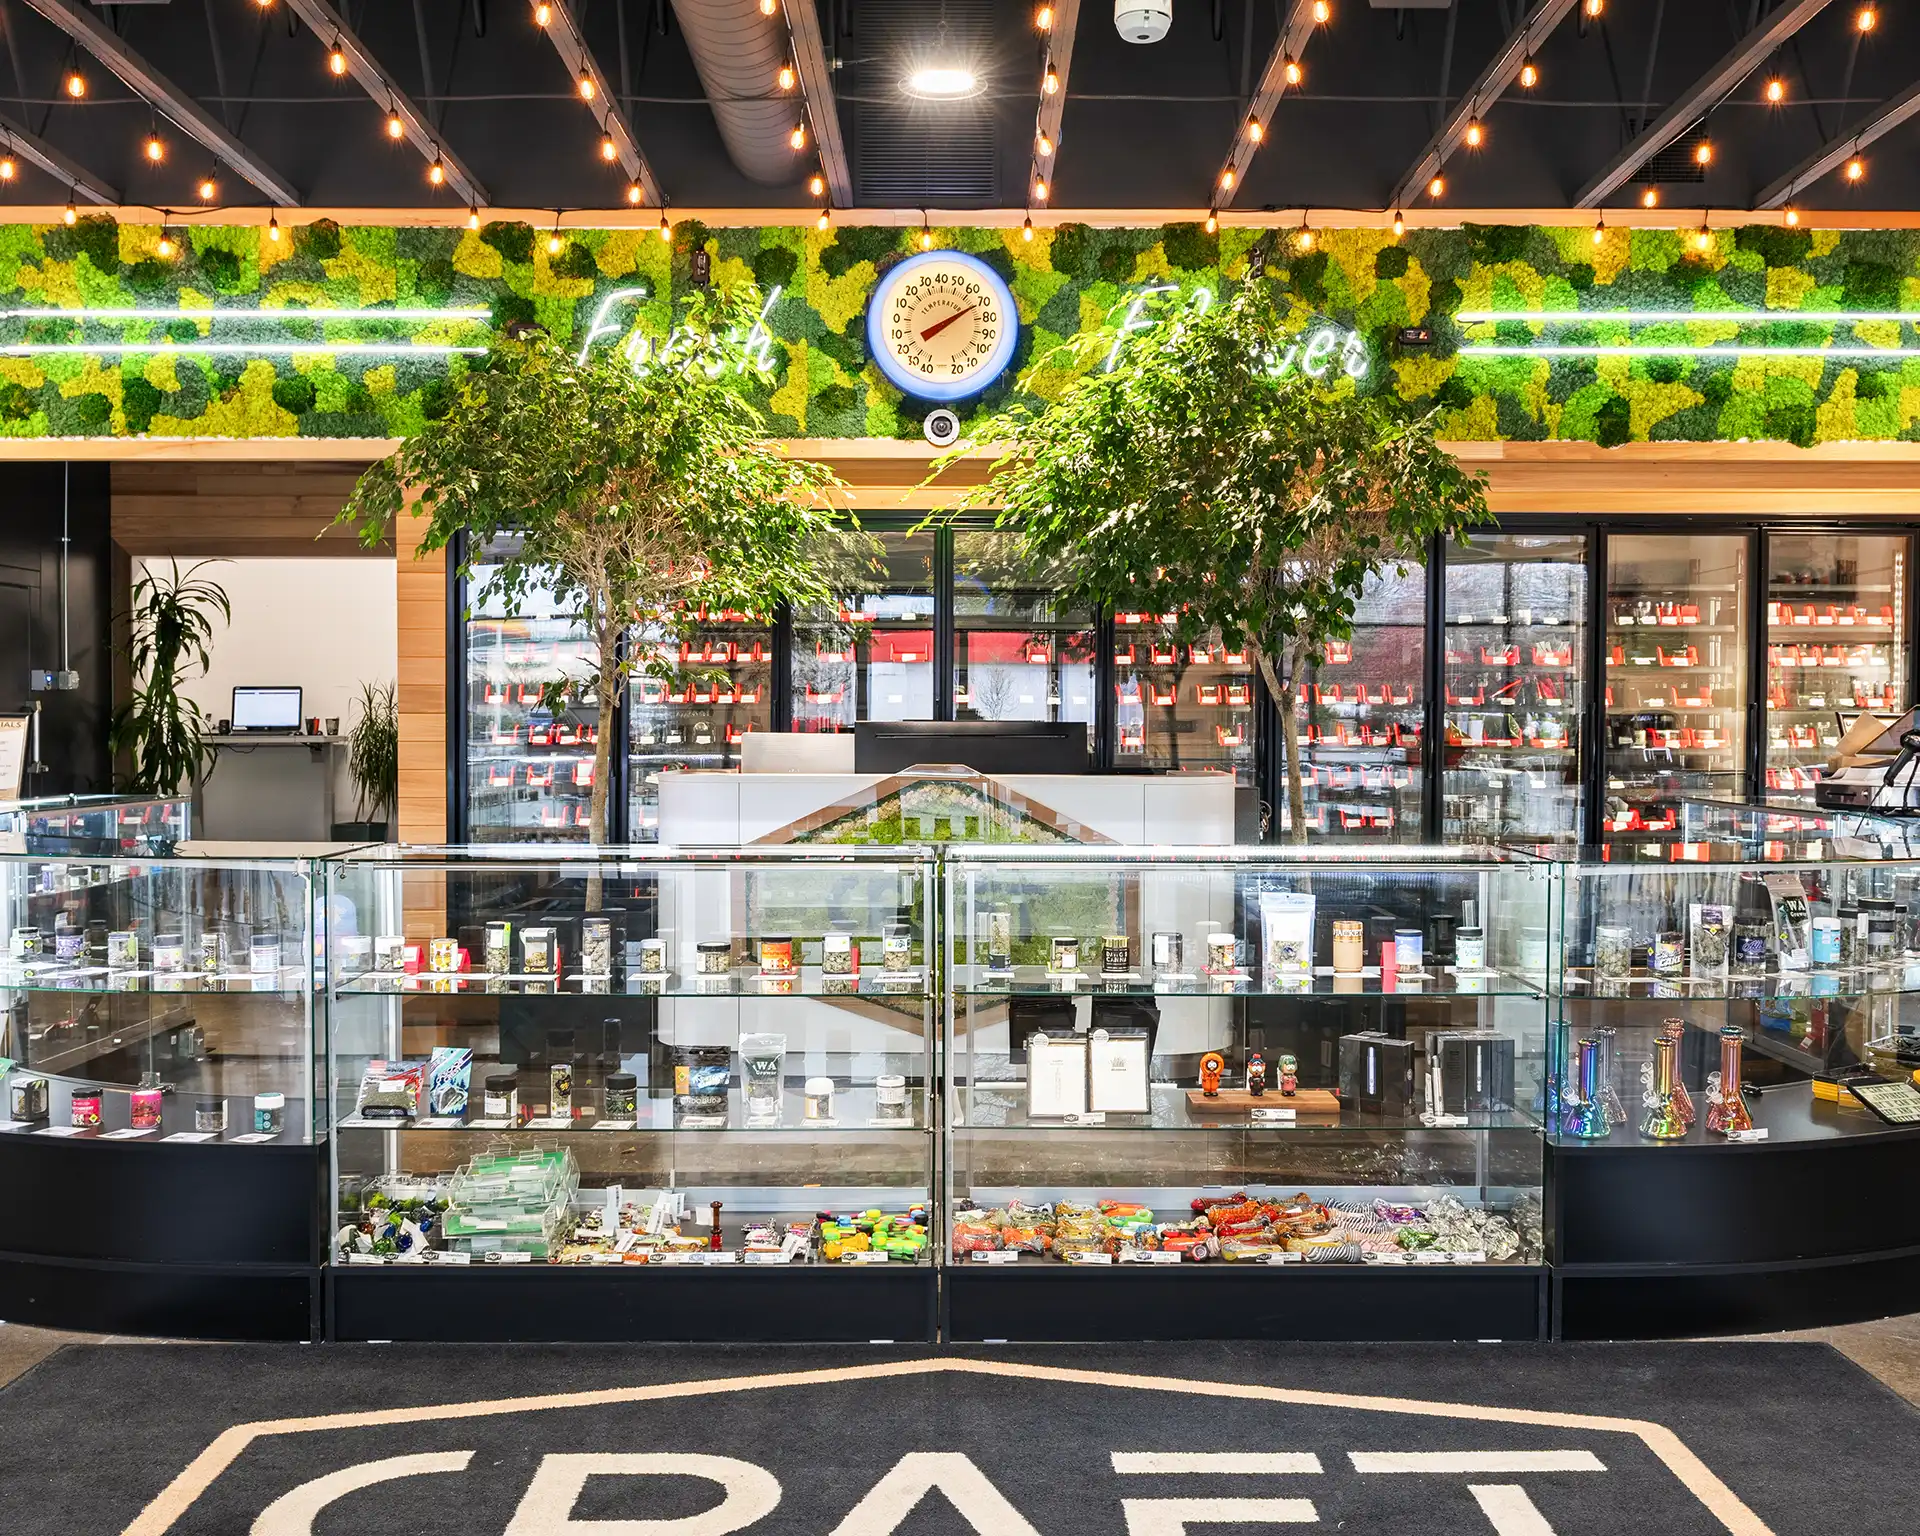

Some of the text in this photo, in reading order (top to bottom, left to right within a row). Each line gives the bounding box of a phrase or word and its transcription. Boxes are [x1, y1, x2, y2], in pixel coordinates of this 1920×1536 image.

[920, 276, 932, 287] 30
[935, 273, 948, 284] 40
[952, 276, 965, 286] 50
[905, 285, 918, 296] 20
[965, 283, 980, 294] 60
[896, 298, 907, 309] 10
[921, 299, 962, 314] TEMPERATUR
[977, 296, 991, 307] 70
[893, 313, 901, 323] 0
[982, 311, 997, 323] 80
[982, 328, 996, 340] 90
[897, 343, 910, 355] 20
[920, 363, 934, 374] 40
[1786, 900, 1806, 911] WA
[756, 1061, 777, 1070] WA
